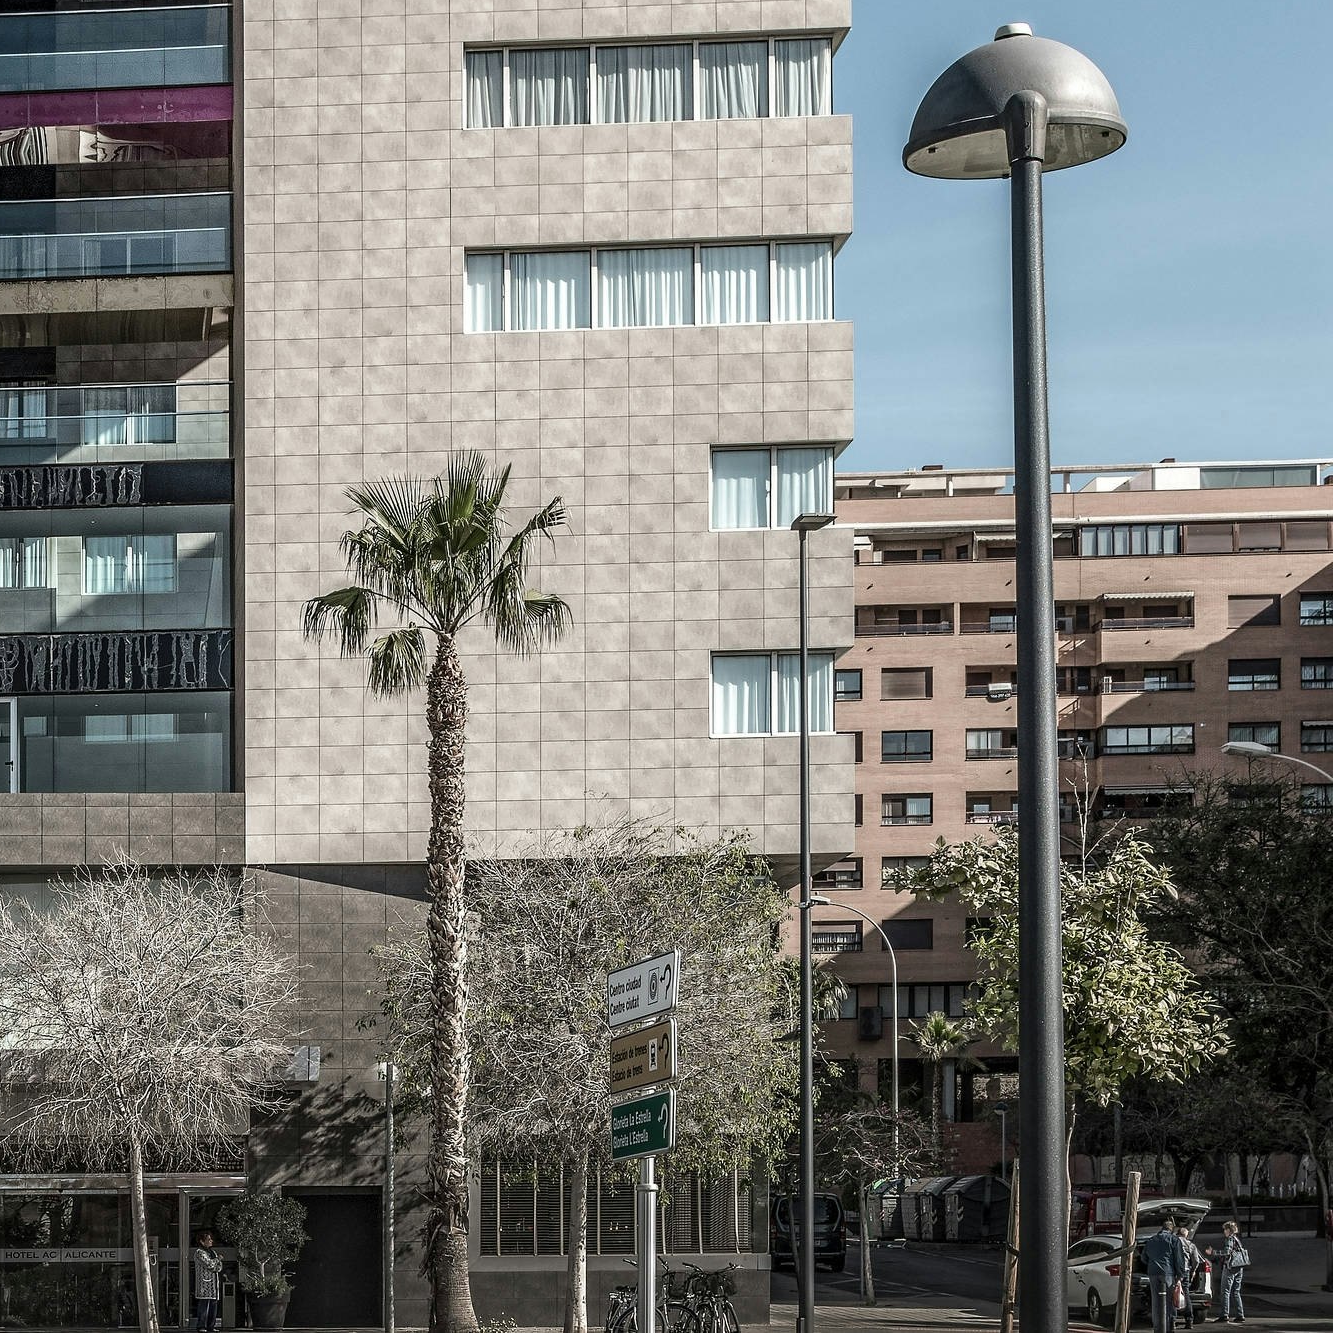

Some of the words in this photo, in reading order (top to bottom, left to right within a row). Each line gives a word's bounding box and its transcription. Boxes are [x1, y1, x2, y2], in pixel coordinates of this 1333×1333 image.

[610, 983, 625, 997] Centro
[626, 975, 641, 992] ciudad
[610, 1001, 625, 1016] Centre
[626, 995, 639, 1011] ciutat
[635, 1109, 651, 1125] Estrella
[5, 1251, 40, 1259] HOTEL
[42, 1251, 57, 1259] AC
[64, 1250, 117, 1259] ALICANTE
